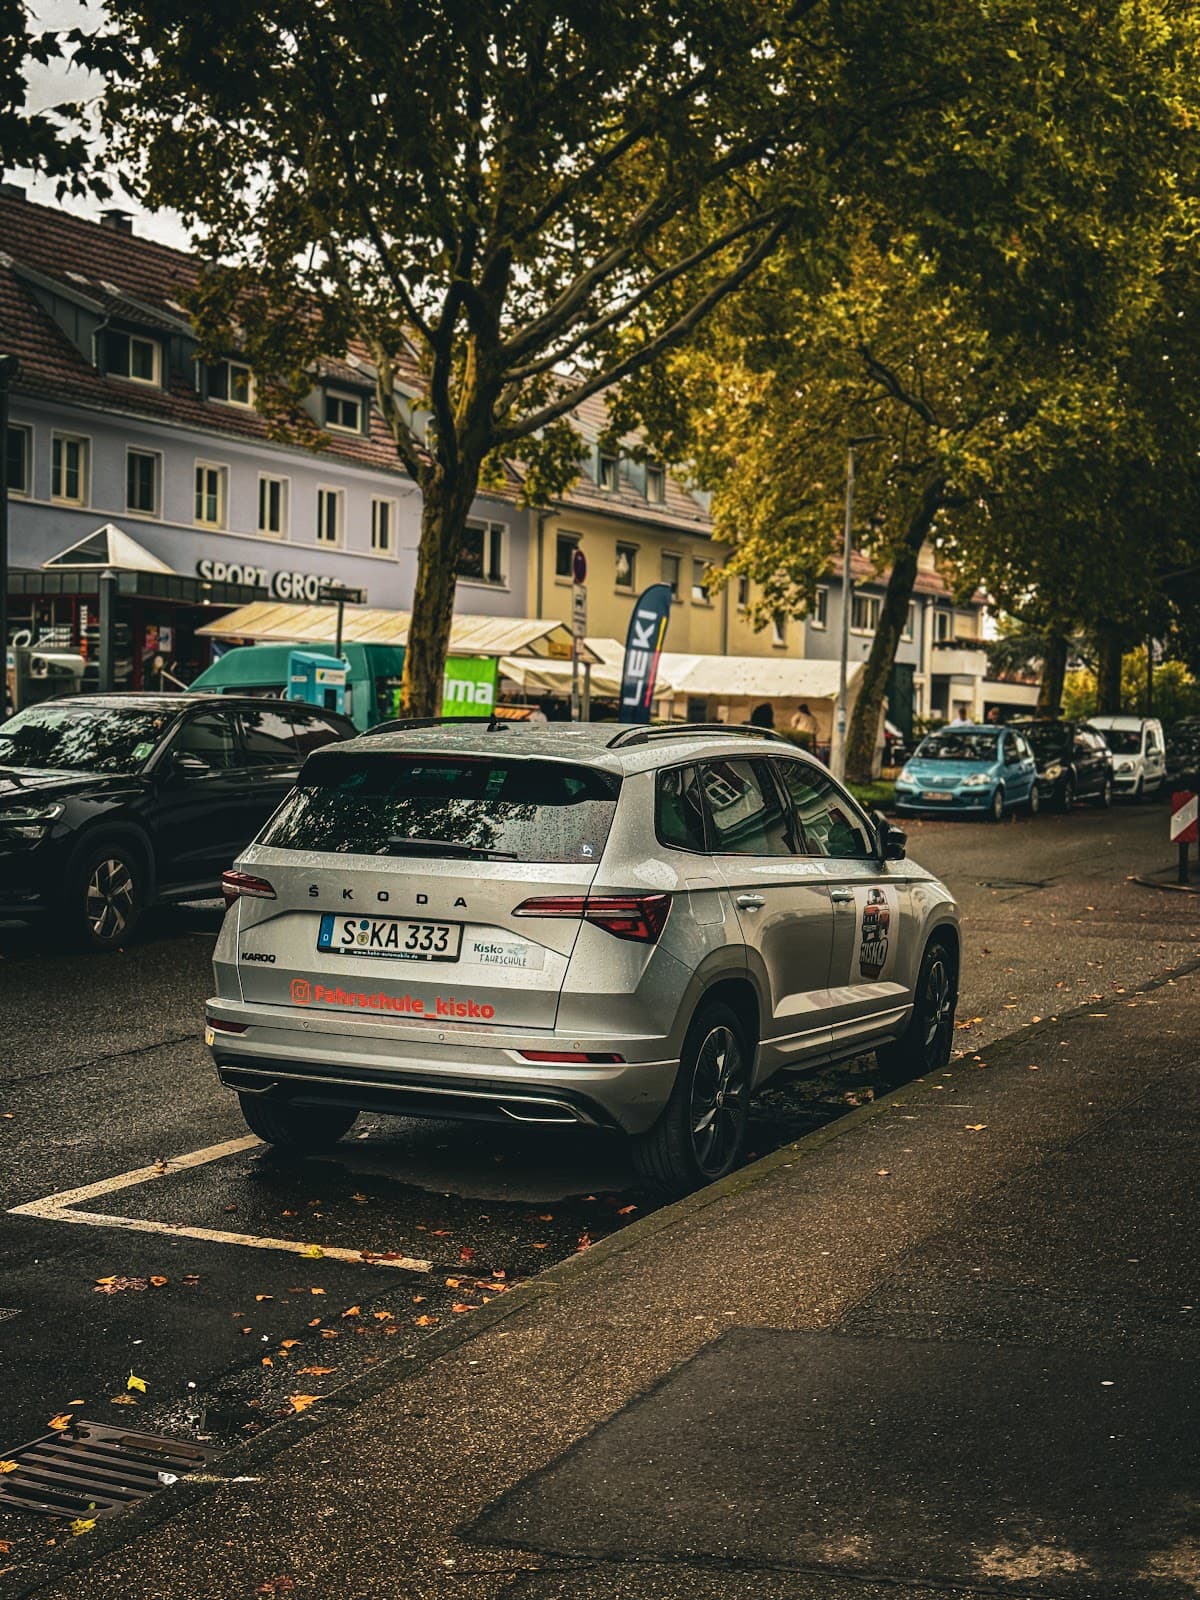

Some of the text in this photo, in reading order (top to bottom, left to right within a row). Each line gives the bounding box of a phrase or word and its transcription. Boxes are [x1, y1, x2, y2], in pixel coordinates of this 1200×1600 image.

[198, 559, 268, 588] SPORT
[623, 609, 657, 706] LEKI
[308, 884, 468, 908] ŠKODA
[404, 924, 450, 952] 333
[473, 943, 504, 954] Kisko
[241, 951, 276, 963] KAROQ
[480, 953, 527, 967] FAHRSCHULE
[314, 985, 495, 1019] Fahrschule_kisko
